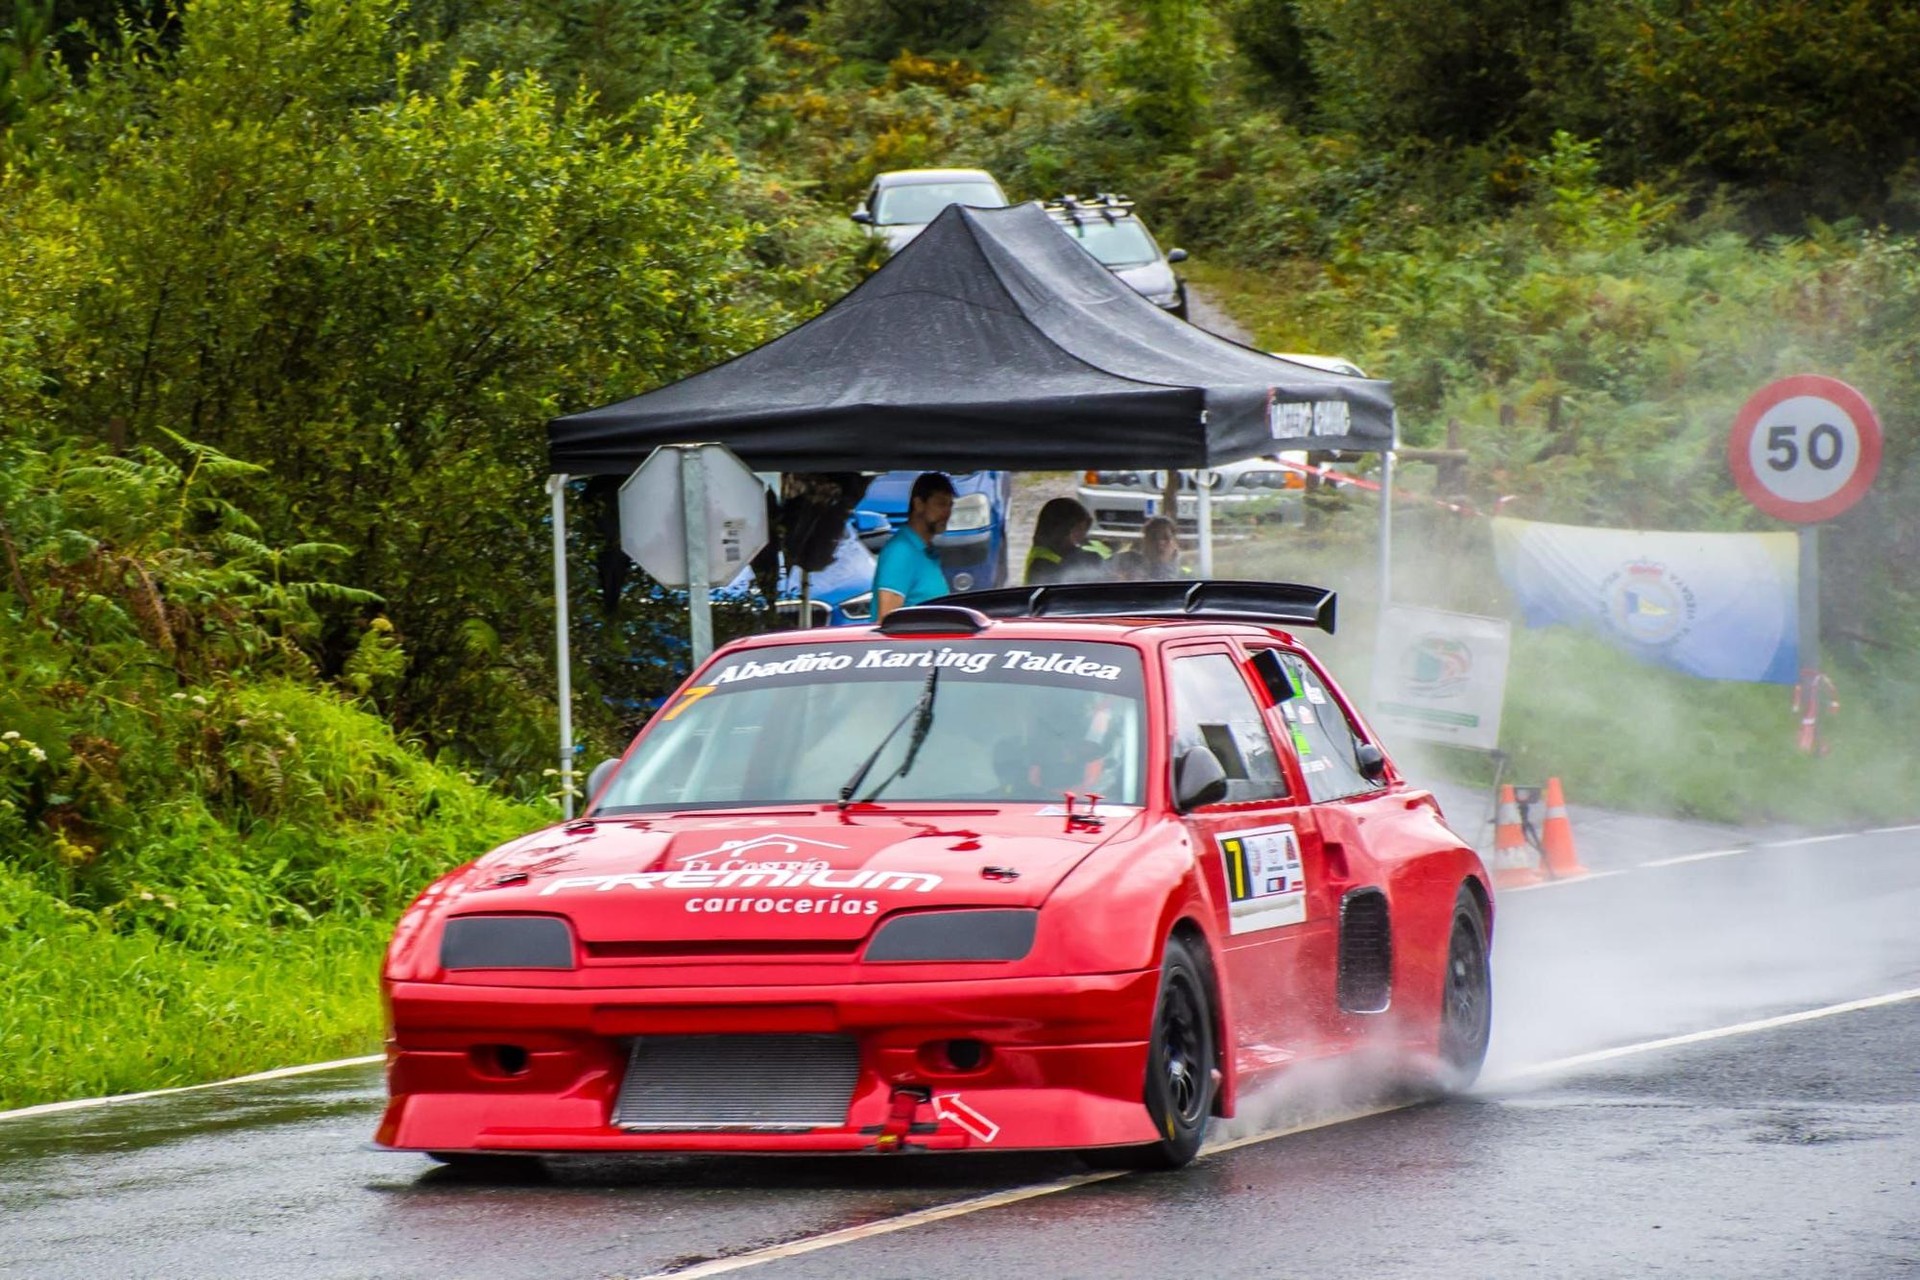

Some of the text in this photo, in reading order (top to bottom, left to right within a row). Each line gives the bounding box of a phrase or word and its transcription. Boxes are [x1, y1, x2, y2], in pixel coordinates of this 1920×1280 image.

[1766, 423, 1844, 472] 50
[708, 647, 1122, 686] Abadiño Karting Taldea
[537, 869, 944, 897] PREMIUM
[684, 894, 879, 915] carrocerías
